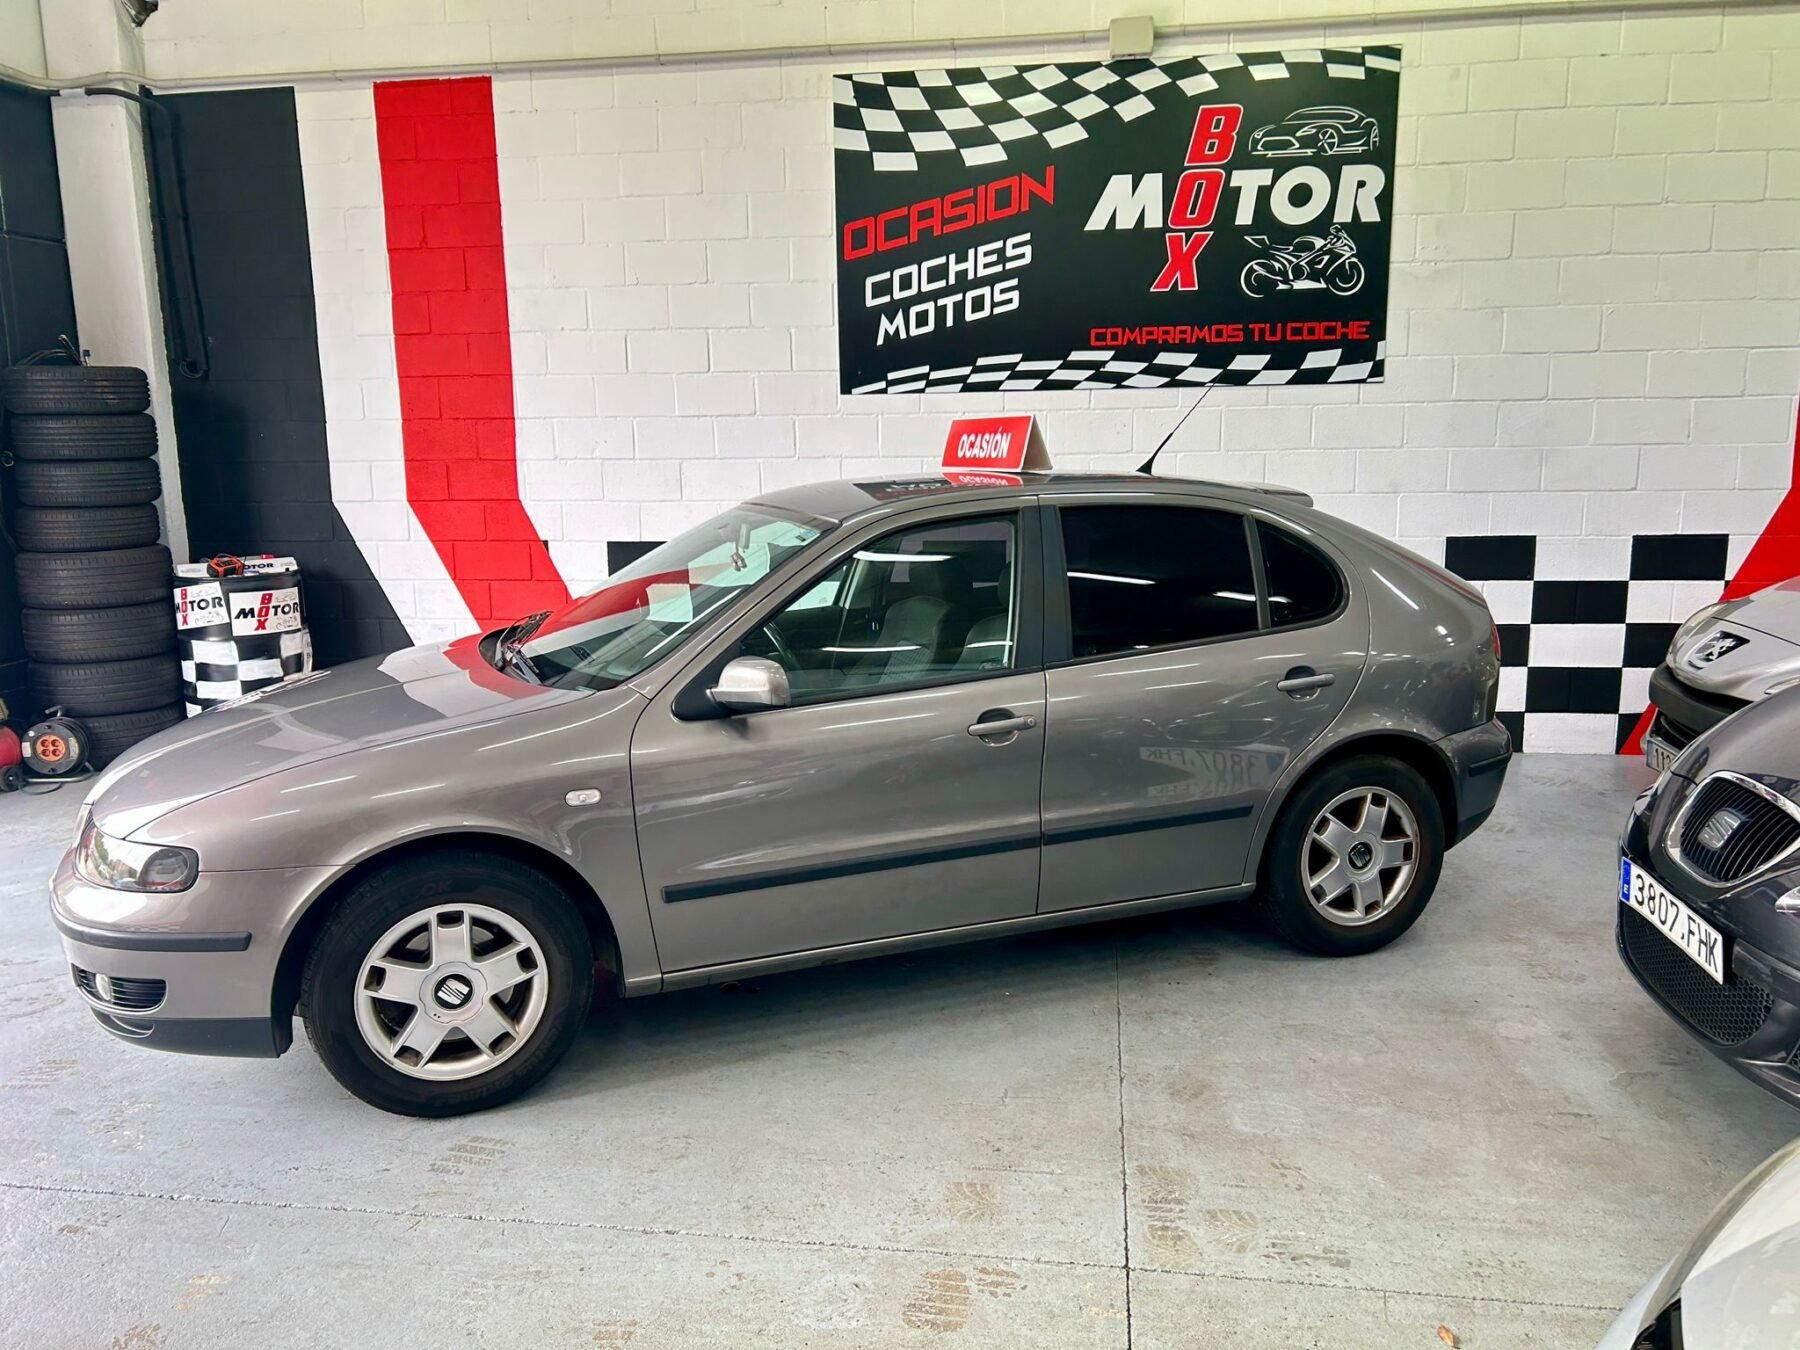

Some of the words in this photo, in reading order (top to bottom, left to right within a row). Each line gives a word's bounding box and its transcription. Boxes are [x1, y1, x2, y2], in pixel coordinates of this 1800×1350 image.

[843, 165, 1055, 261] OCASION
[1083, 164, 1386, 231] MOTOR
[1150, 103, 1244, 292] BOX
[865, 232, 1032, 308] COCHES
[876, 277, 1020, 346] MOTOS
[1090, 323, 1244, 347] COMPRAMOS
[1249, 323, 1282, 342] TU
[1286, 321, 1371, 341] COCHE
[957, 426, 1012, 459] OCASIÓN
[234, 601, 299, 620] MOTOR
[1634, 873, 1680, 933] 3807
[1687, 913, 1718, 974] FHK
